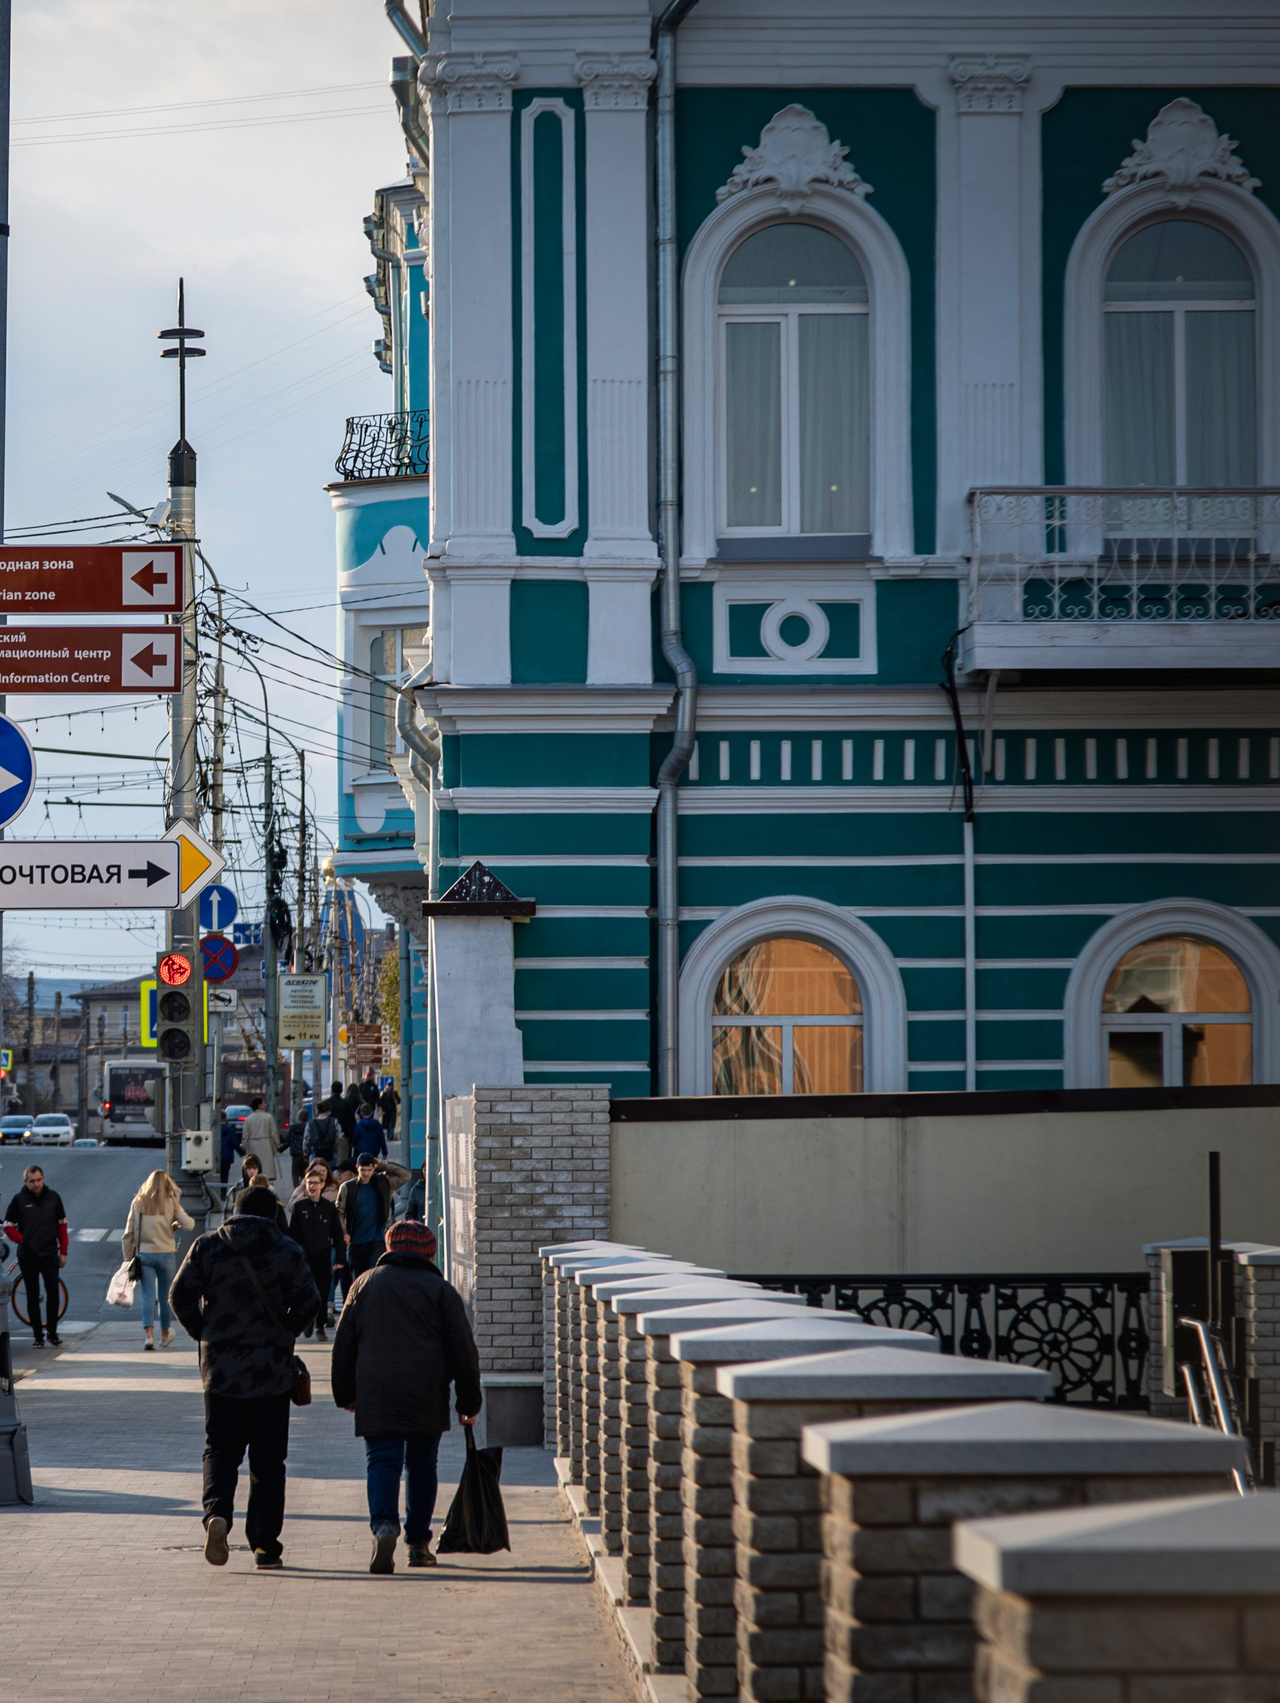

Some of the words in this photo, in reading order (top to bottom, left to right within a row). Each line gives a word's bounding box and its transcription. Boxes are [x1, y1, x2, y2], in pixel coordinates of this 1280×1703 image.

[42, 560, 74, 570] зона
[24, 591, 56, 600] zone
[74, 649, 111, 661] центр
[71, 672, 111, 683] Centre
[298, 1032, 307, 1040] 11
